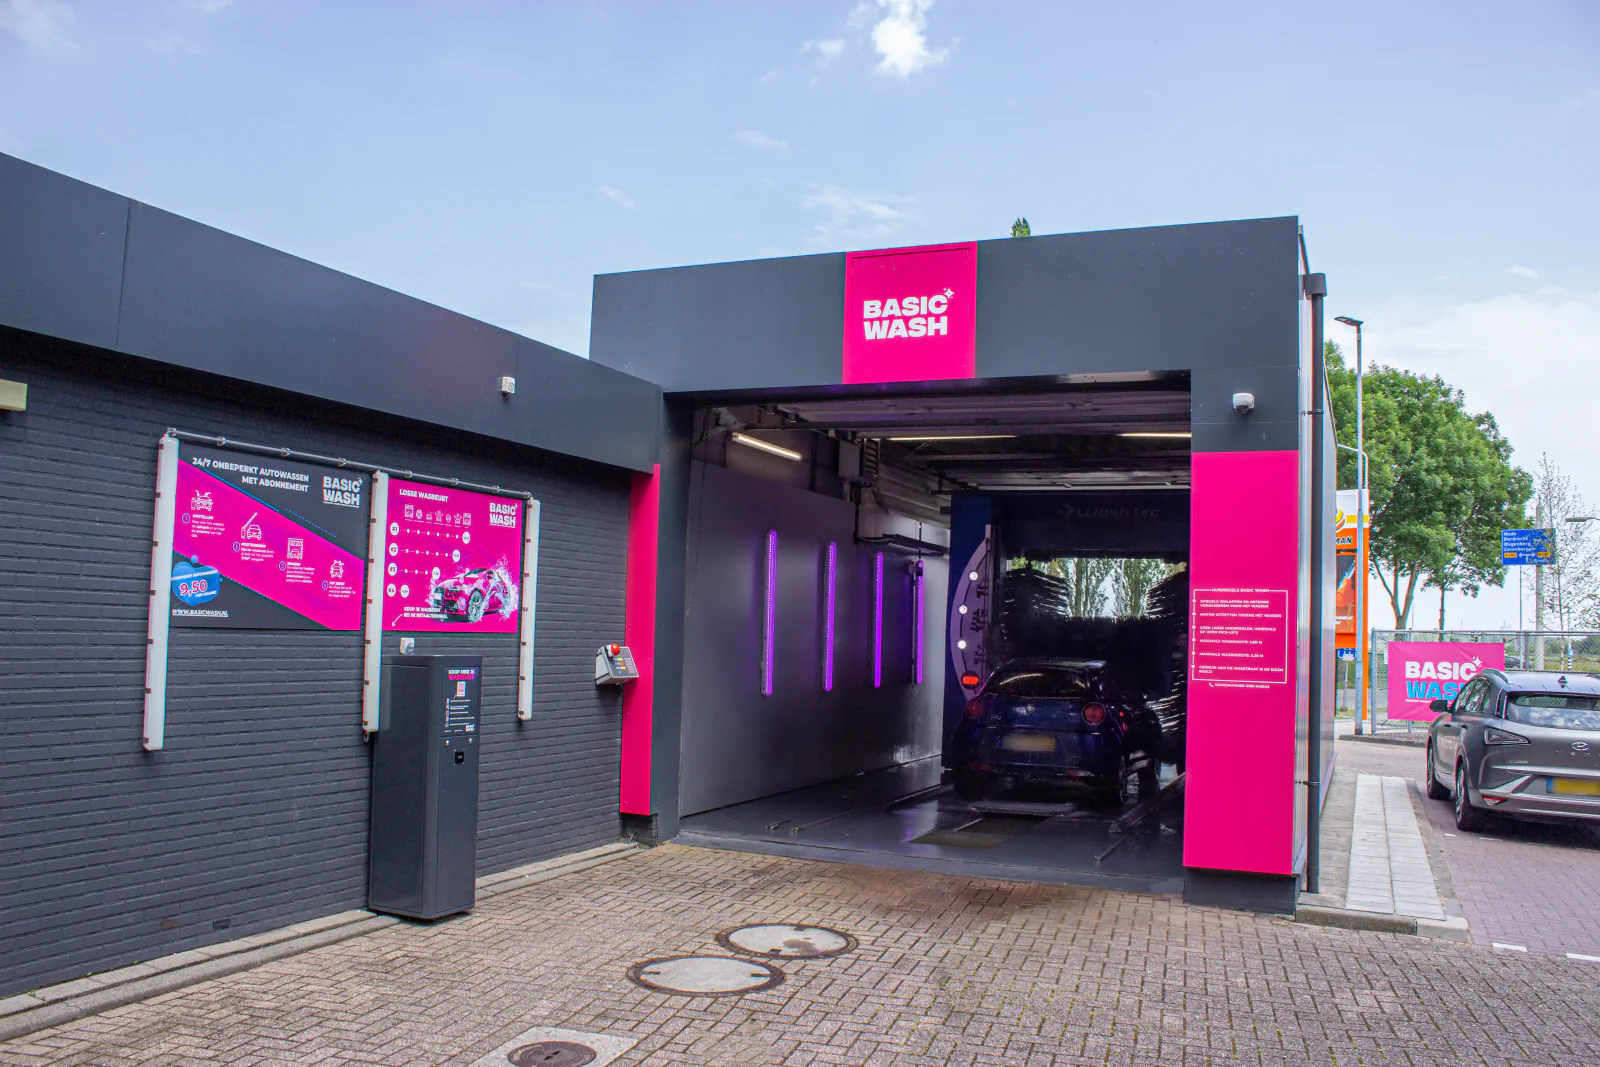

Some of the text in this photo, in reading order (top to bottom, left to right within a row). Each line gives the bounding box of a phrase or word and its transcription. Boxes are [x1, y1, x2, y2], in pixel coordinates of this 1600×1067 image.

[863, 294, 948, 319] BASIC
[863, 316, 948, 340] WASH
[192, 457, 310, 482] 24/7 ONBEPERKT AUTOWASSEN
[241, 475, 309, 492] MET ABONNEMENT
[322, 476, 361, 493] BASIC
[322, 488, 361, 506] WASH
[399, 488, 449, 502] LOSSE WASBEURT
[489, 502, 516, 514] BASIC
[489, 513, 516, 527] WASH
[179, 579, 208, 597] 9,50
[172, 608, 229, 617] WWW.BASICWASH.NL
[1405, 661, 1476, 681] BASIC
[1406, 680, 1467, 701] WAS
